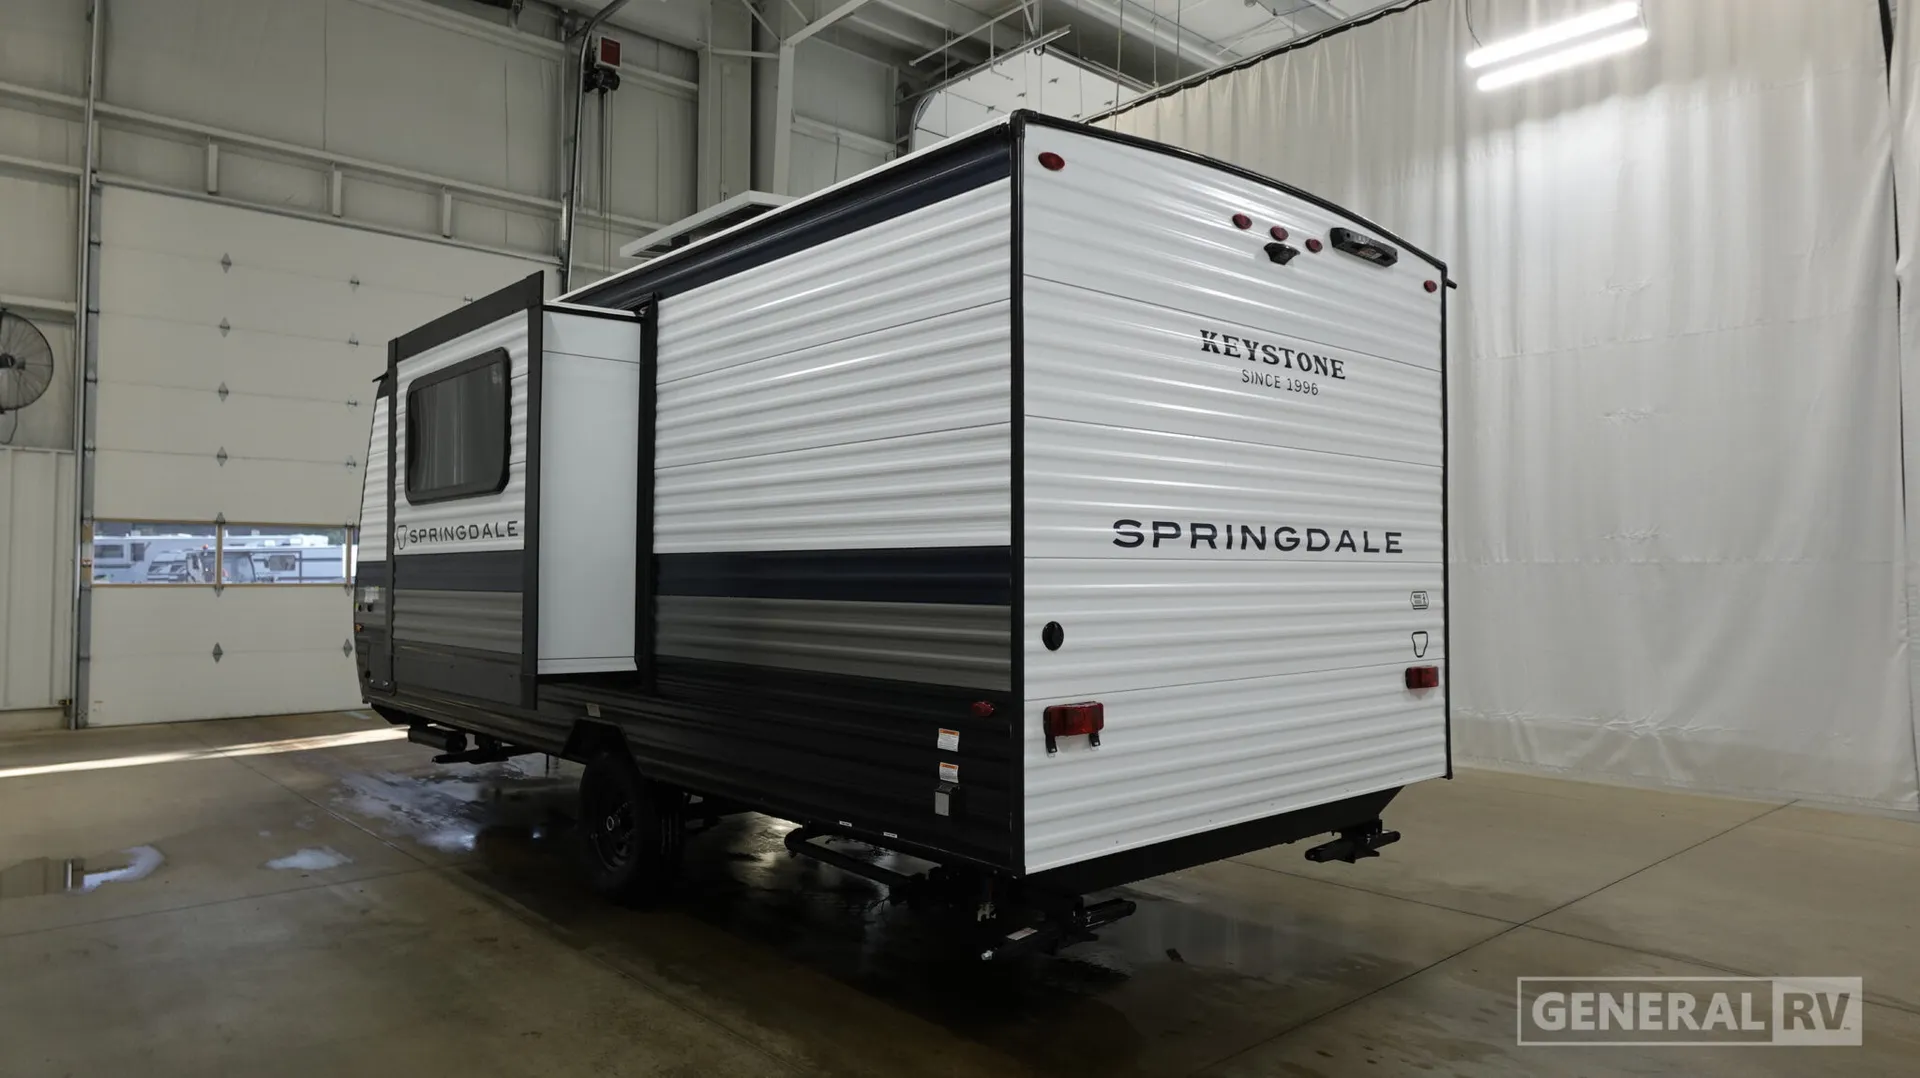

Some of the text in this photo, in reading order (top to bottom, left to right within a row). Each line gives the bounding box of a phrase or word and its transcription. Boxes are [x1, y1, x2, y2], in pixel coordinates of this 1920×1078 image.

[1200, 329, 1346, 380] KEYSTONE
[1241, 369, 1319, 396] SINCE 1996
[409, 520, 519, 544] SPRINGDALE
[1112, 519, 1404, 554] SPRINGDALE
